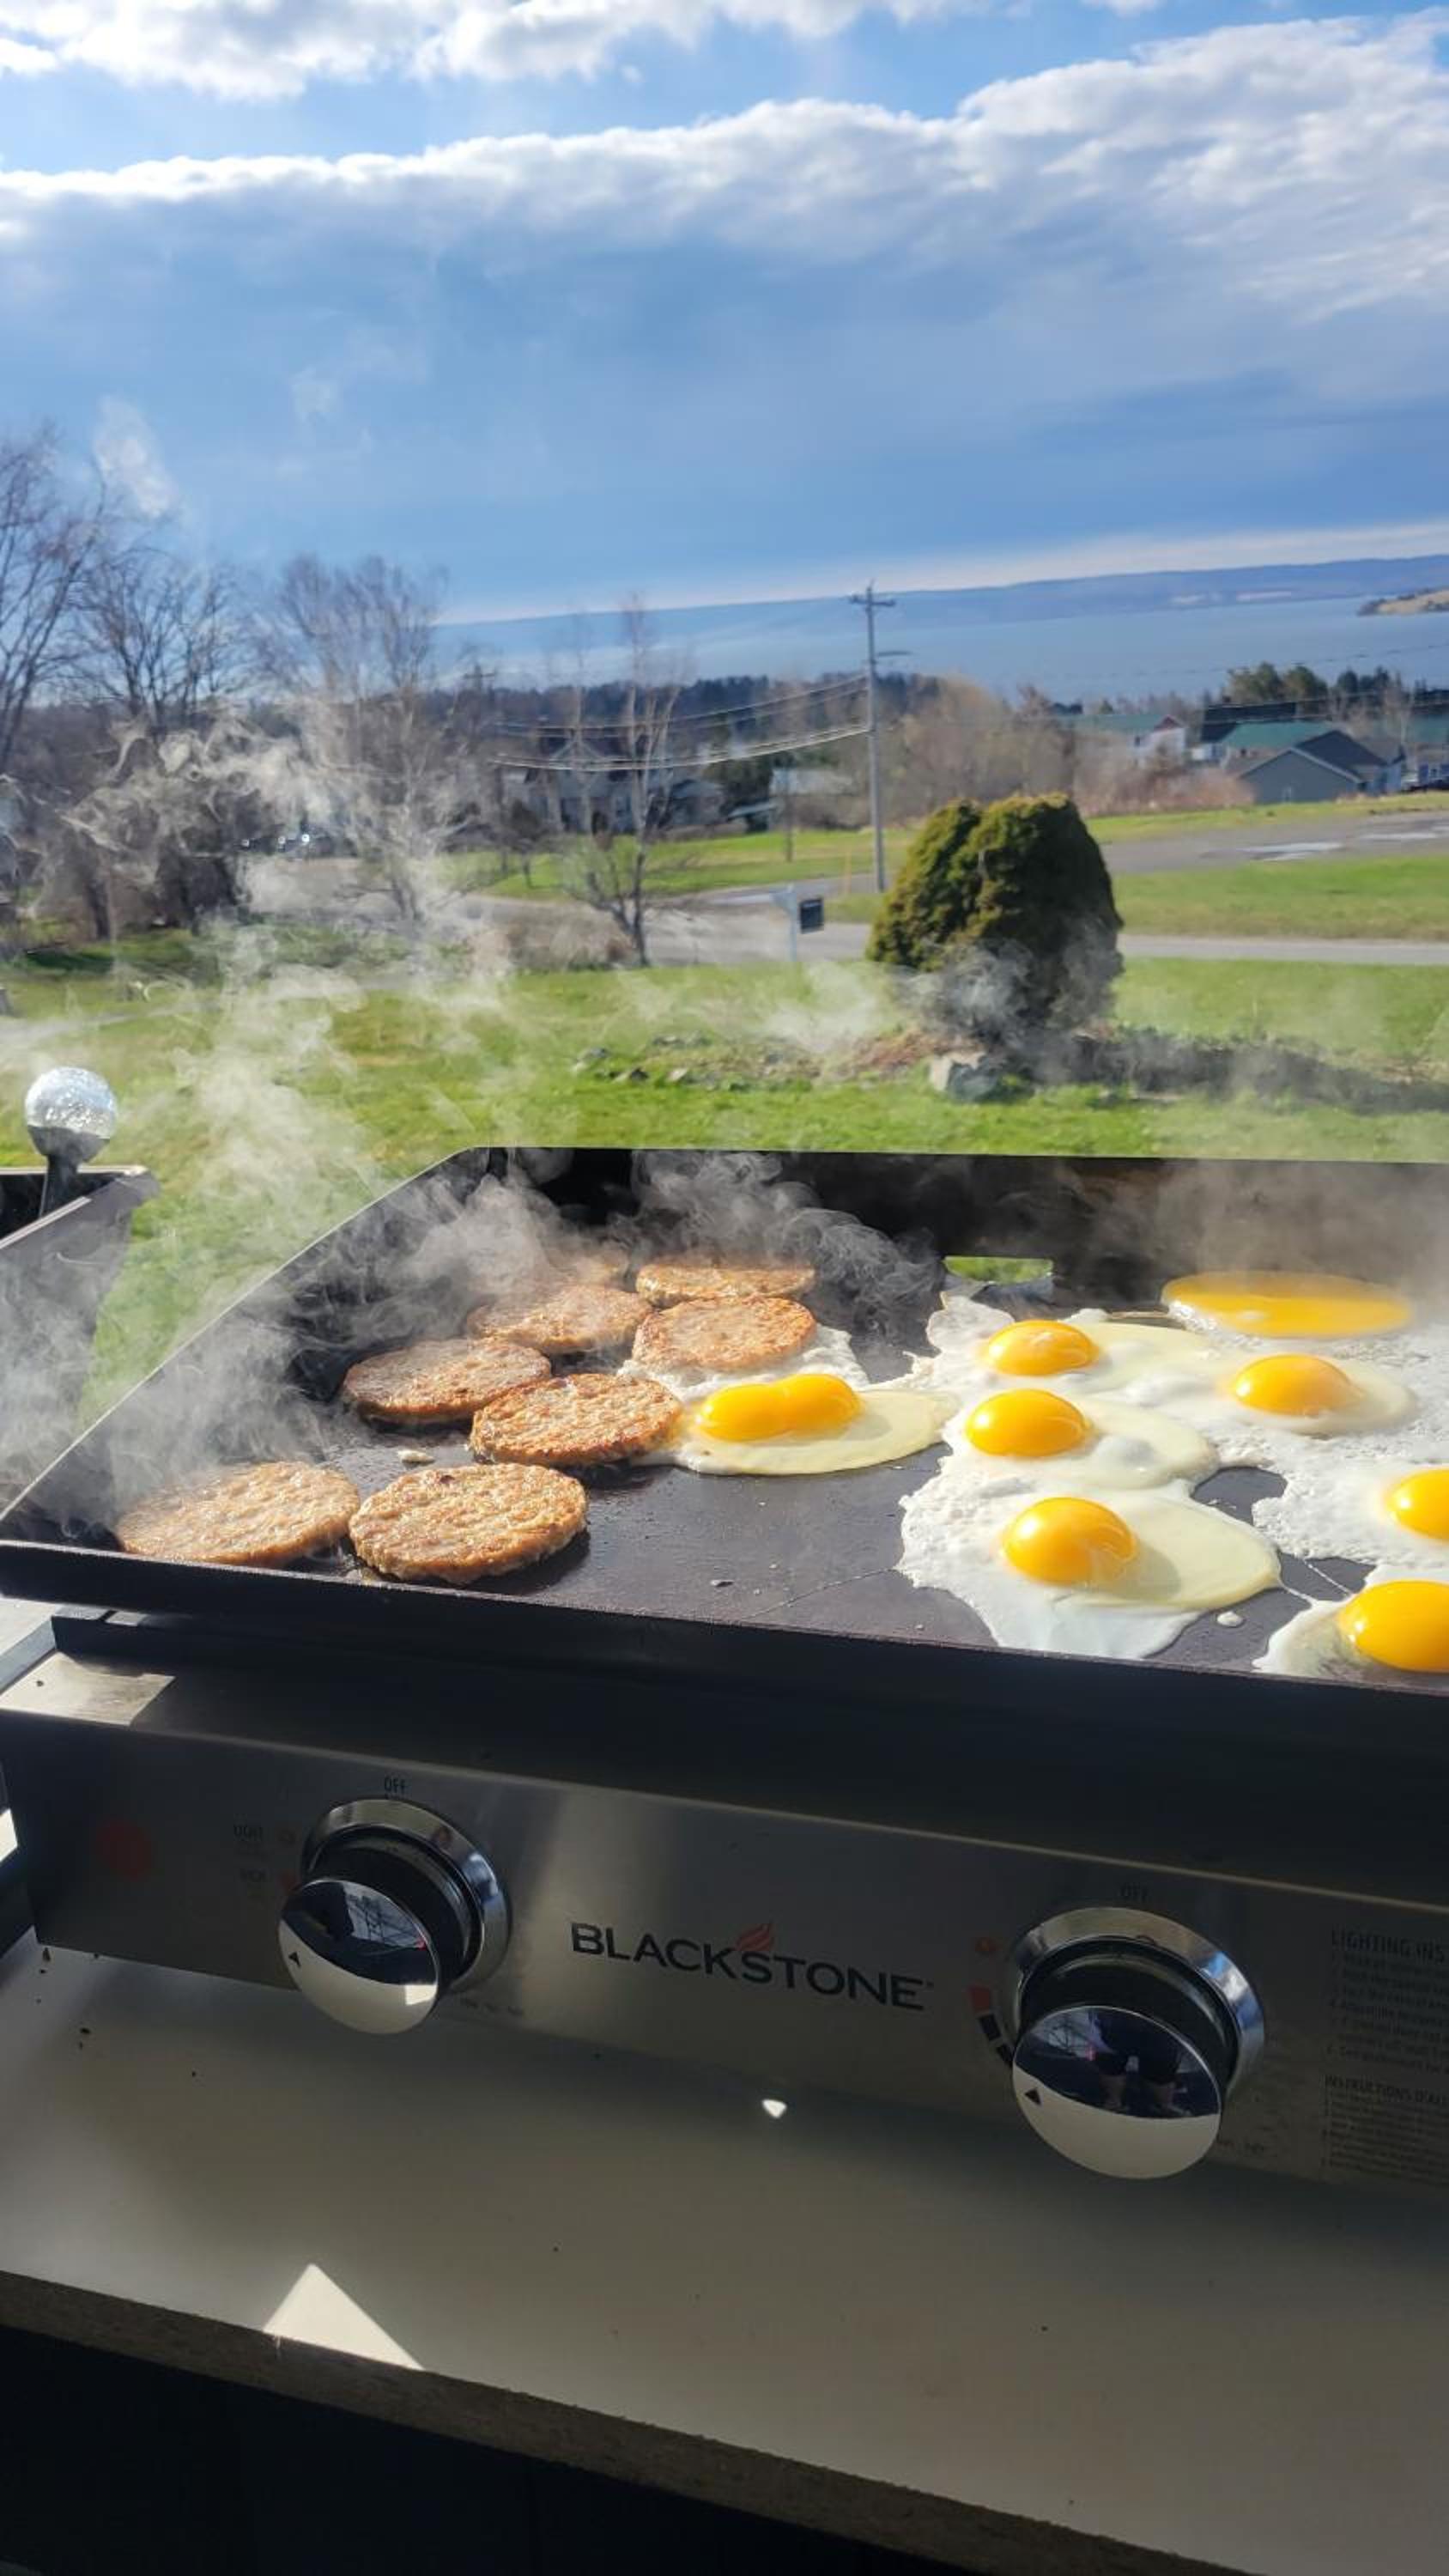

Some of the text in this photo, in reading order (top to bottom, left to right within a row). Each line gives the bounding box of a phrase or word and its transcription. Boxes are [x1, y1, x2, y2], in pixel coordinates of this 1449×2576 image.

[384, 1774, 408, 1795] OFF
[1331, 1929, 1410, 1958] LIGHTING
[571, 1921, 925, 2011] BLACKSTONE
